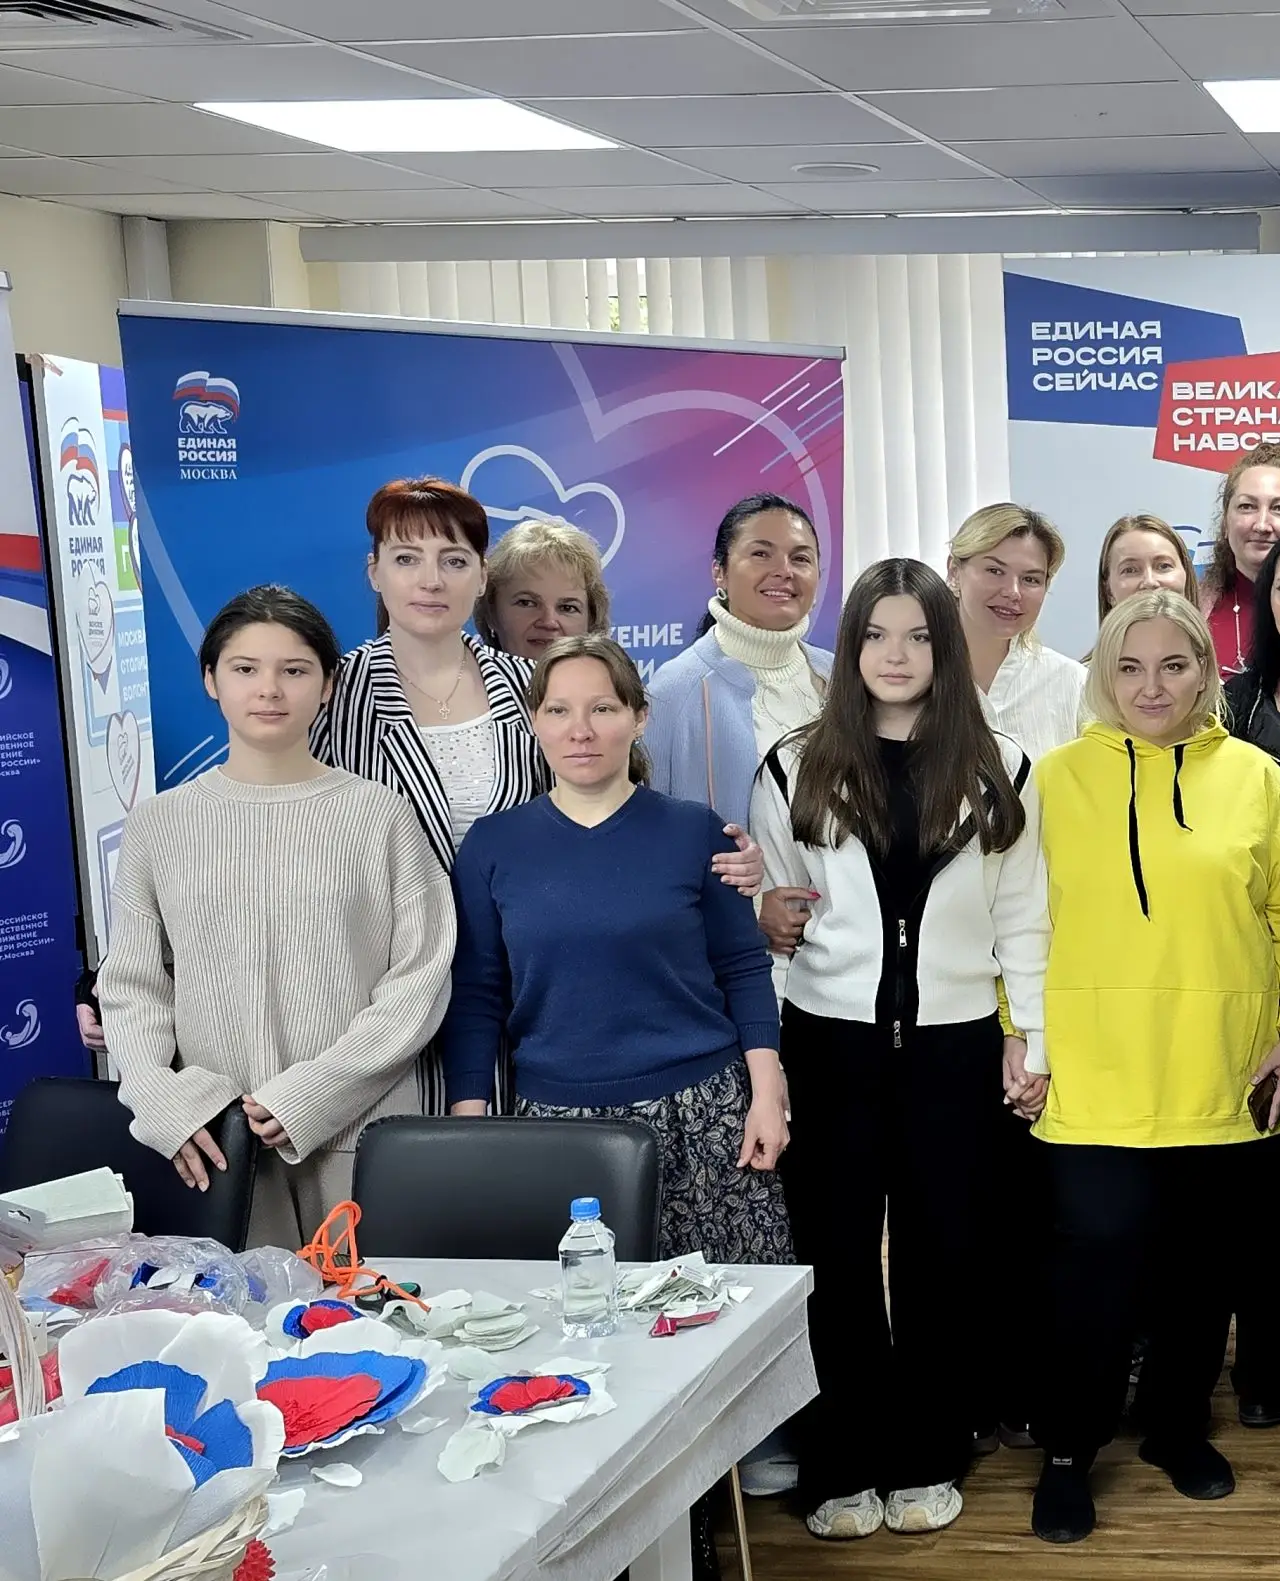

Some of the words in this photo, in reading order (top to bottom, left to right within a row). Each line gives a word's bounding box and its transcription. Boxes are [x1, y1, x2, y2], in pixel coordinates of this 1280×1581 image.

[1031, 320, 1162, 341] ЕДИНАЯ
[1032, 346, 1163, 366] РОССИЯ
[1032, 369, 1159, 392] СЕЙЧАС
[178, 437, 237, 450] ЕДИНАЯ
[178, 450, 237, 462] РОССИЯ
[180, 468, 238, 480] МОСКВА
[69, 536, 104, 556] ЕДИНАЯ
[71, 558, 105, 578] РОЯ
[0, 732, 35, 742] ИЙСКОЕ
[0, 741, 35, 751] ВЕННОЕ
[0, 751, 24, 760] ЕНИЕ
[0, 912, 49, 926] ОССИЙСКОЕ
[0, 920, 49, 934] ЕСТВЕННОЕ
